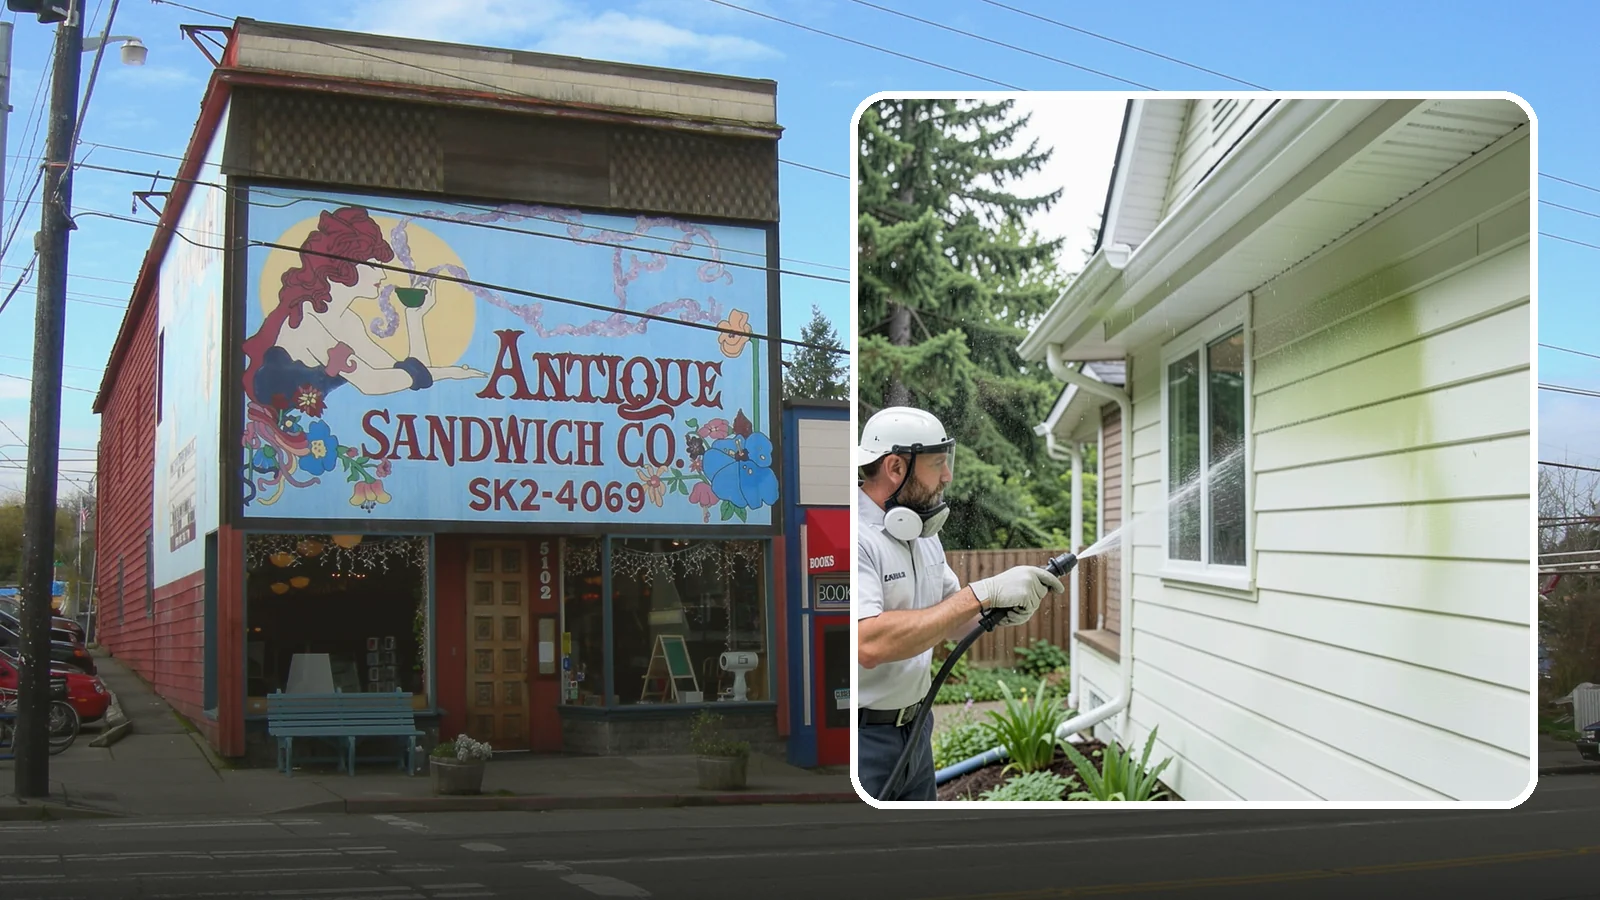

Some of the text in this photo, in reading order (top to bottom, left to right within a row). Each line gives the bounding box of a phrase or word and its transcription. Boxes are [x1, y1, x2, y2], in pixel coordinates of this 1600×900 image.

[476, 329, 724, 420] ANTIQUE
[361, 408, 685, 468] SANDWICH CO.
[468, 477, 646, 513] SK2-4069
[539, 542, 552, 600] 5102
[809, 555, 835, 568] BOOKS
